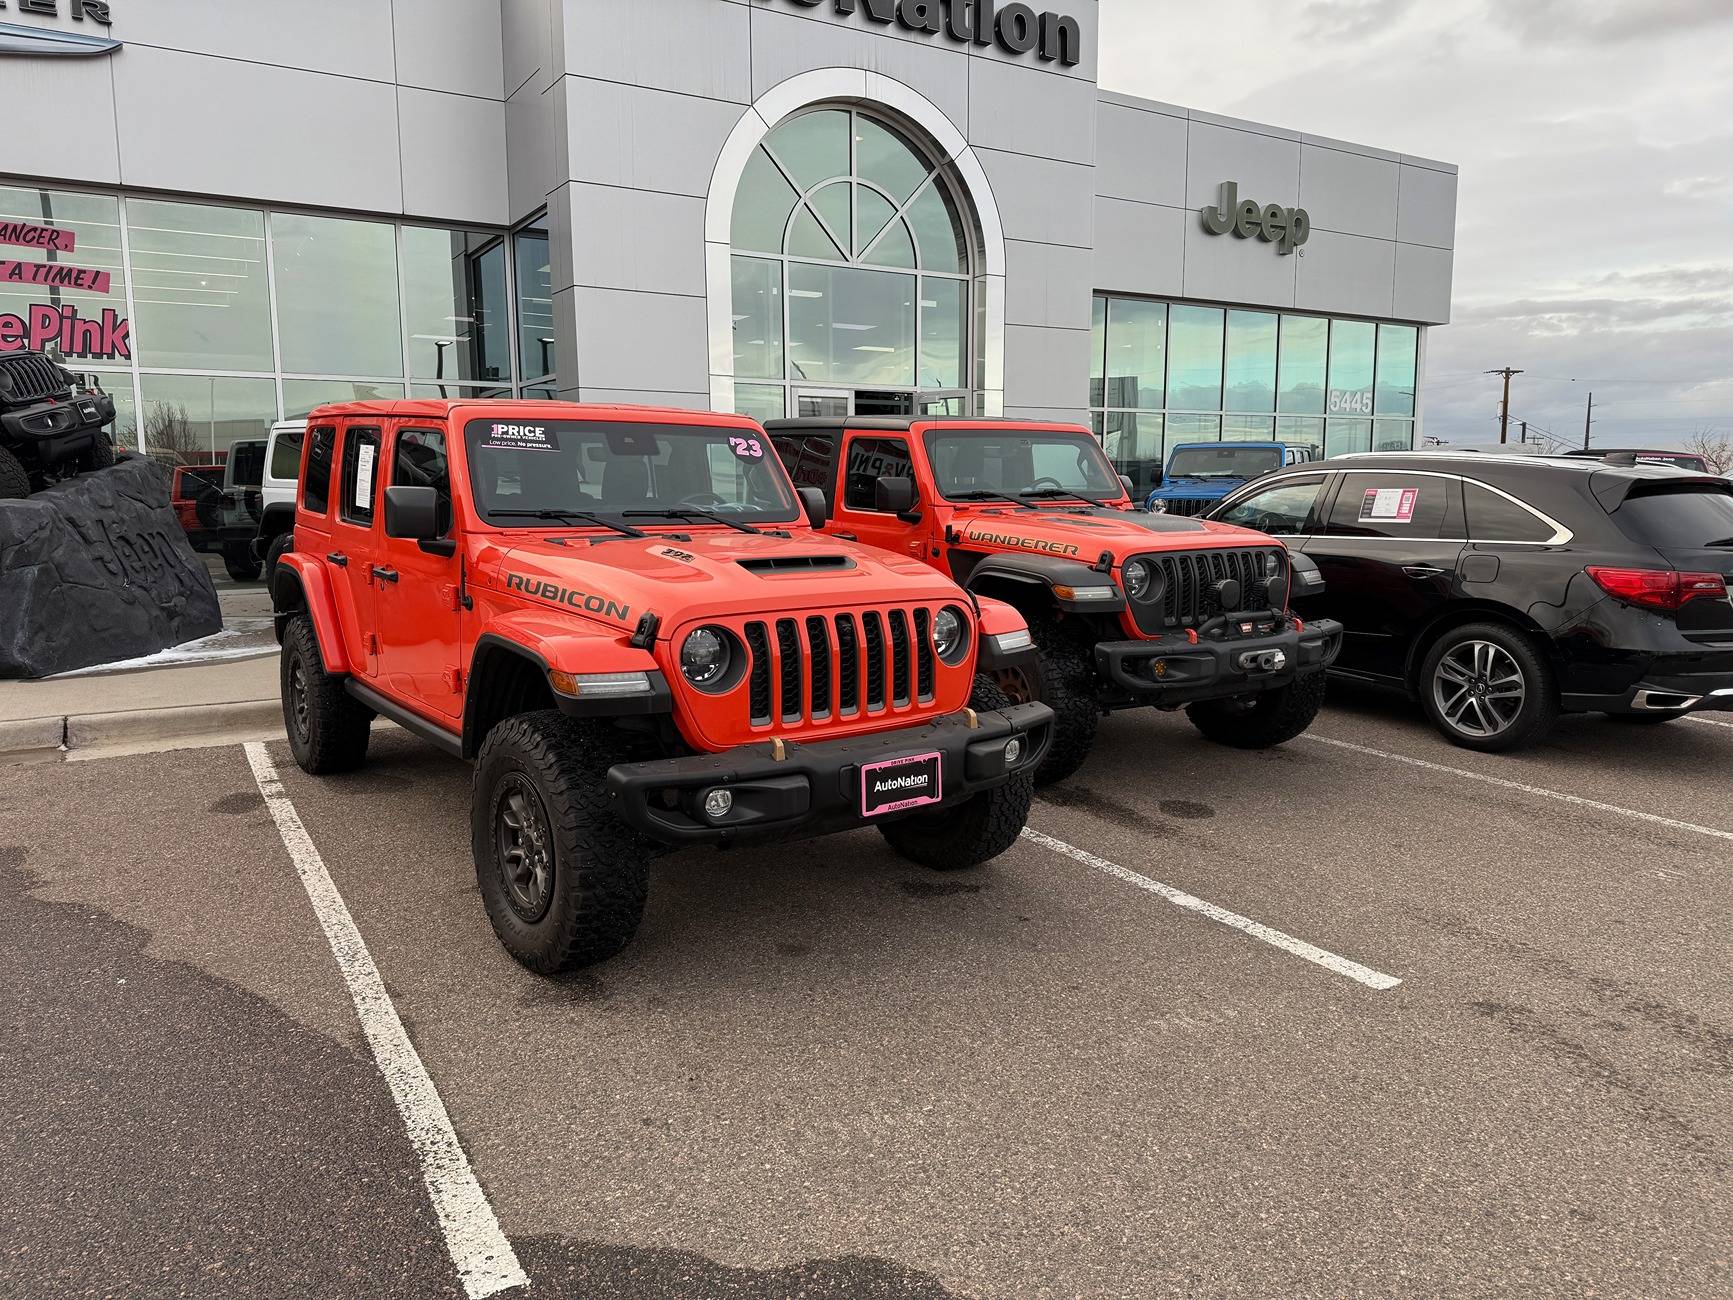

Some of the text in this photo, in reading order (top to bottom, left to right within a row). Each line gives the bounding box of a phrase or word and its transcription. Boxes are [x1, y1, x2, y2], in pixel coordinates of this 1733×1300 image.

[1199, 180, 1310, 256] Jeep
[8, 262, 101, 290] A TIME!
[1329, 390, 1372, 413] 5445
[729, 437, 763, 457] '23
[969, 530, 1080, 556] WANDERER
[506, 573, 630, 621] RUBICON
[874, 775, 928, 792] AutoNation
[888, 800, 918, 810] AutoNation
